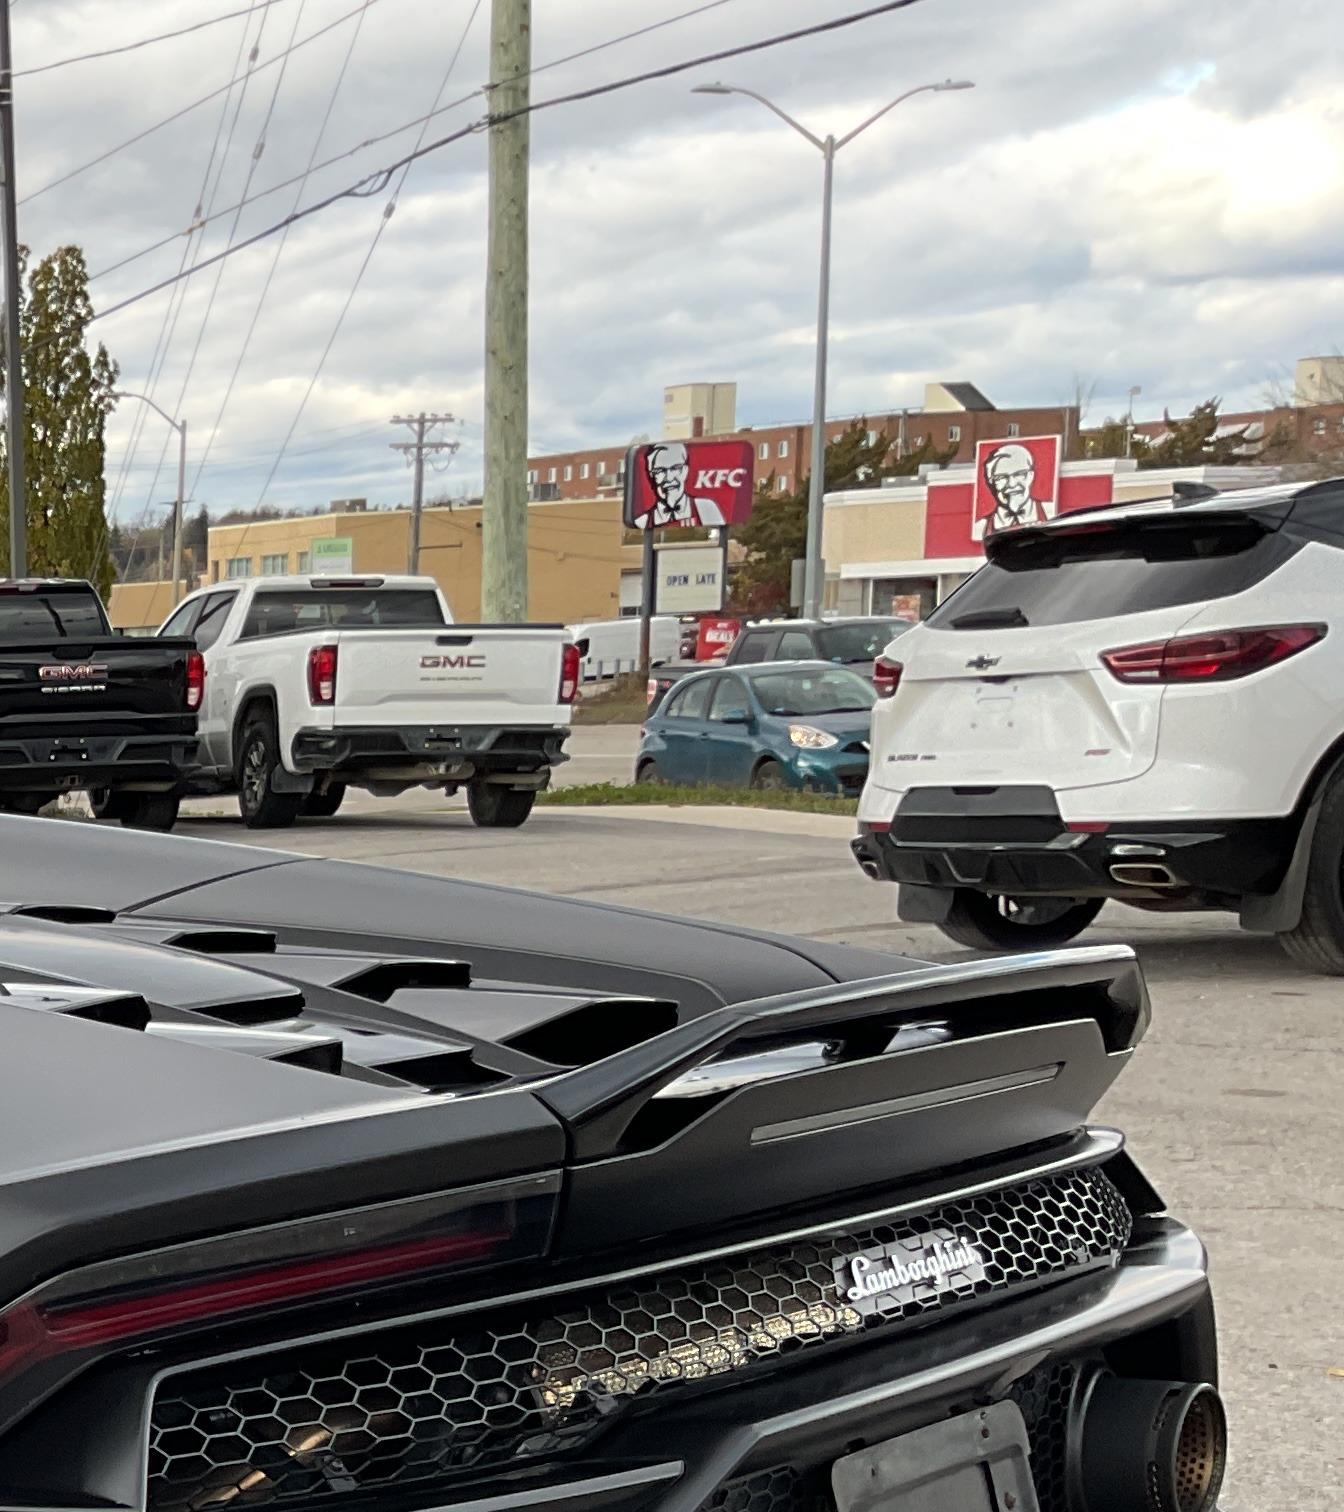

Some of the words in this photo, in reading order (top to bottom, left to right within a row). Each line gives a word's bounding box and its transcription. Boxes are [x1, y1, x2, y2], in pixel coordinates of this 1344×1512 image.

[694, 468, 747, 489] KFC
[666, 574, 689, 586] OPEN
[695, 573, 716, 585] LATE
[419, 655, 486, 668] GMC
[38, 664, 109, 680] GMC
[847, 1236, 981, 1301] Lamborghini
